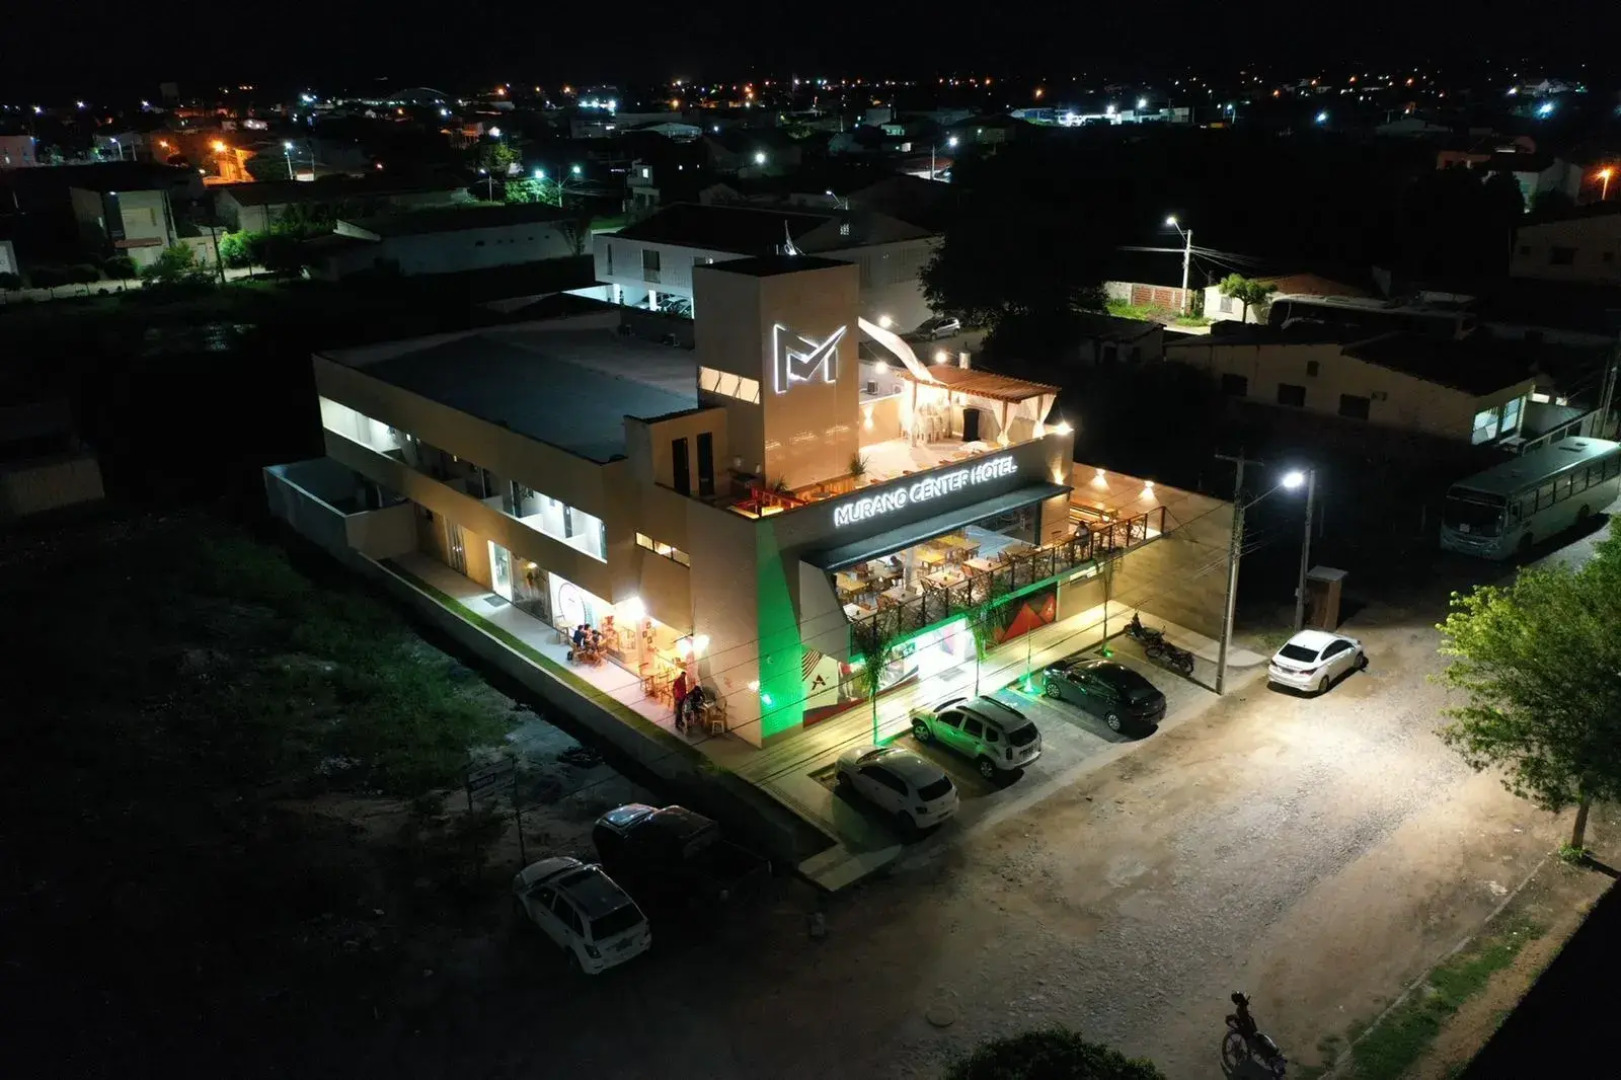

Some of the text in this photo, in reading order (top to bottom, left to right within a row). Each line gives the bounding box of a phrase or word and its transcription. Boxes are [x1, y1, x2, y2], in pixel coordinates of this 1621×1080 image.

[834, 456, 1018, 527] MURANO CENTER HOTEL
